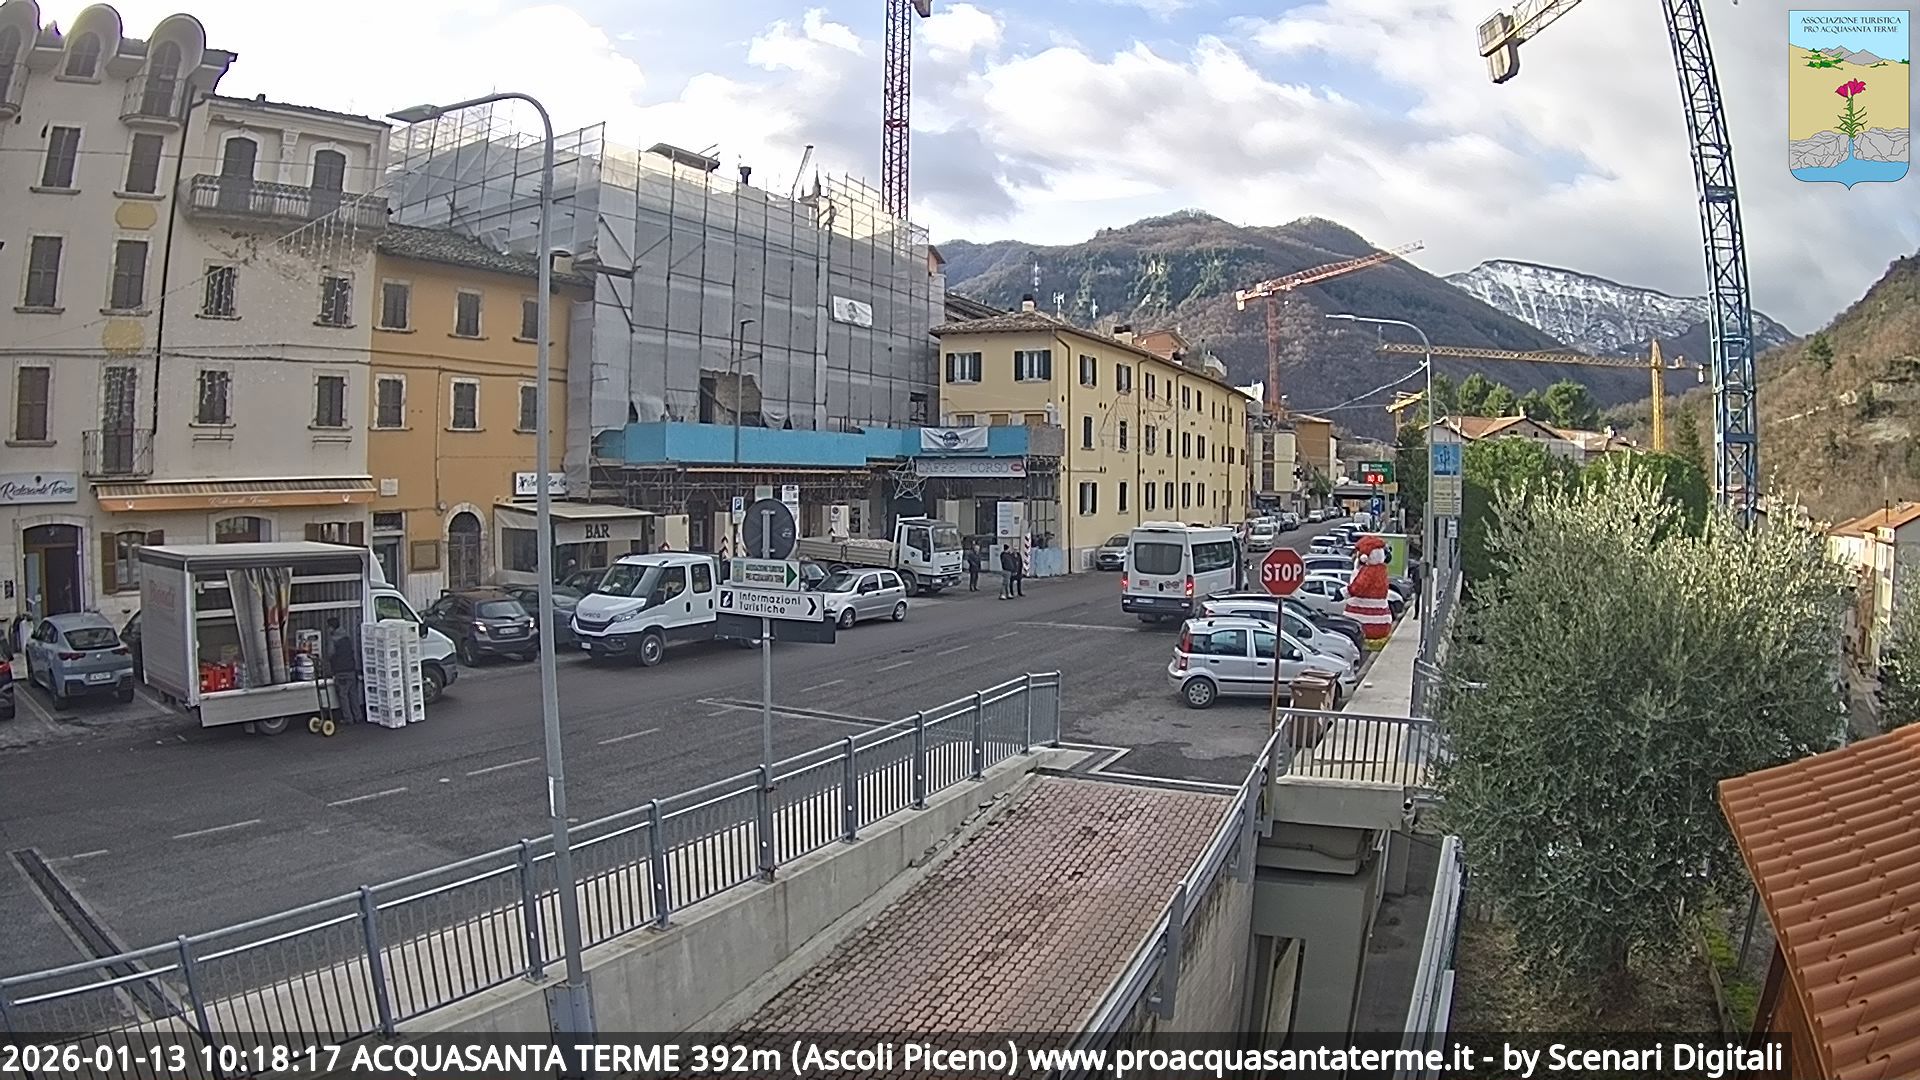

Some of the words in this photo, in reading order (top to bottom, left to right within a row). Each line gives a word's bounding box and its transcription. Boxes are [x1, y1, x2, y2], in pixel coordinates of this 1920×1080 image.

[585, 523, 611, 539] BAR
[1263, 563, 1302, 582] STOP
[739, 592, 801, 606] Informazioni
[739, 601, 786, 614] Turistiche
